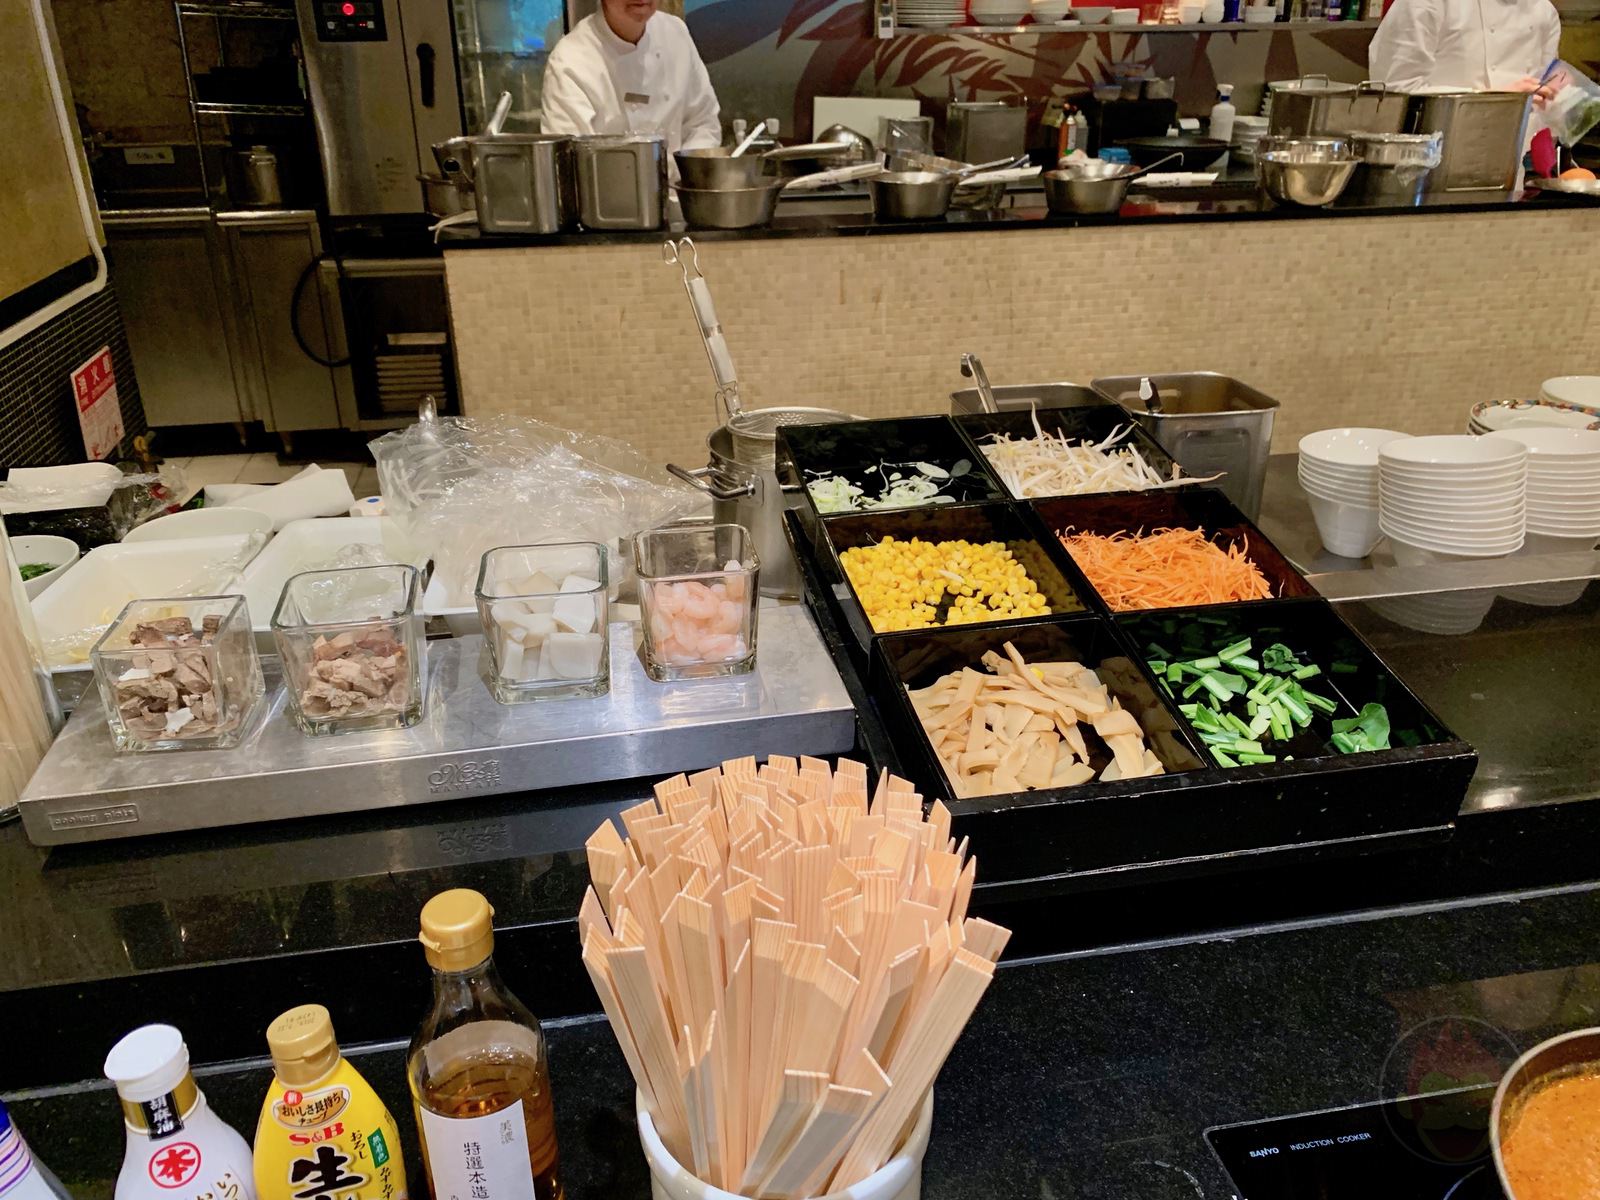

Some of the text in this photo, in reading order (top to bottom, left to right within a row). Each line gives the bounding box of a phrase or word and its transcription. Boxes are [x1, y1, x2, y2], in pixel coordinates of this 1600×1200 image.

[149, 1094, 175, 1135] 胡麻油
[288, 1122, 345, 1147] S&B
[1249, 1132, 1372, 1159] SANYO INDUCTION COOKER
[287, 1146, 364, 1200] 生
